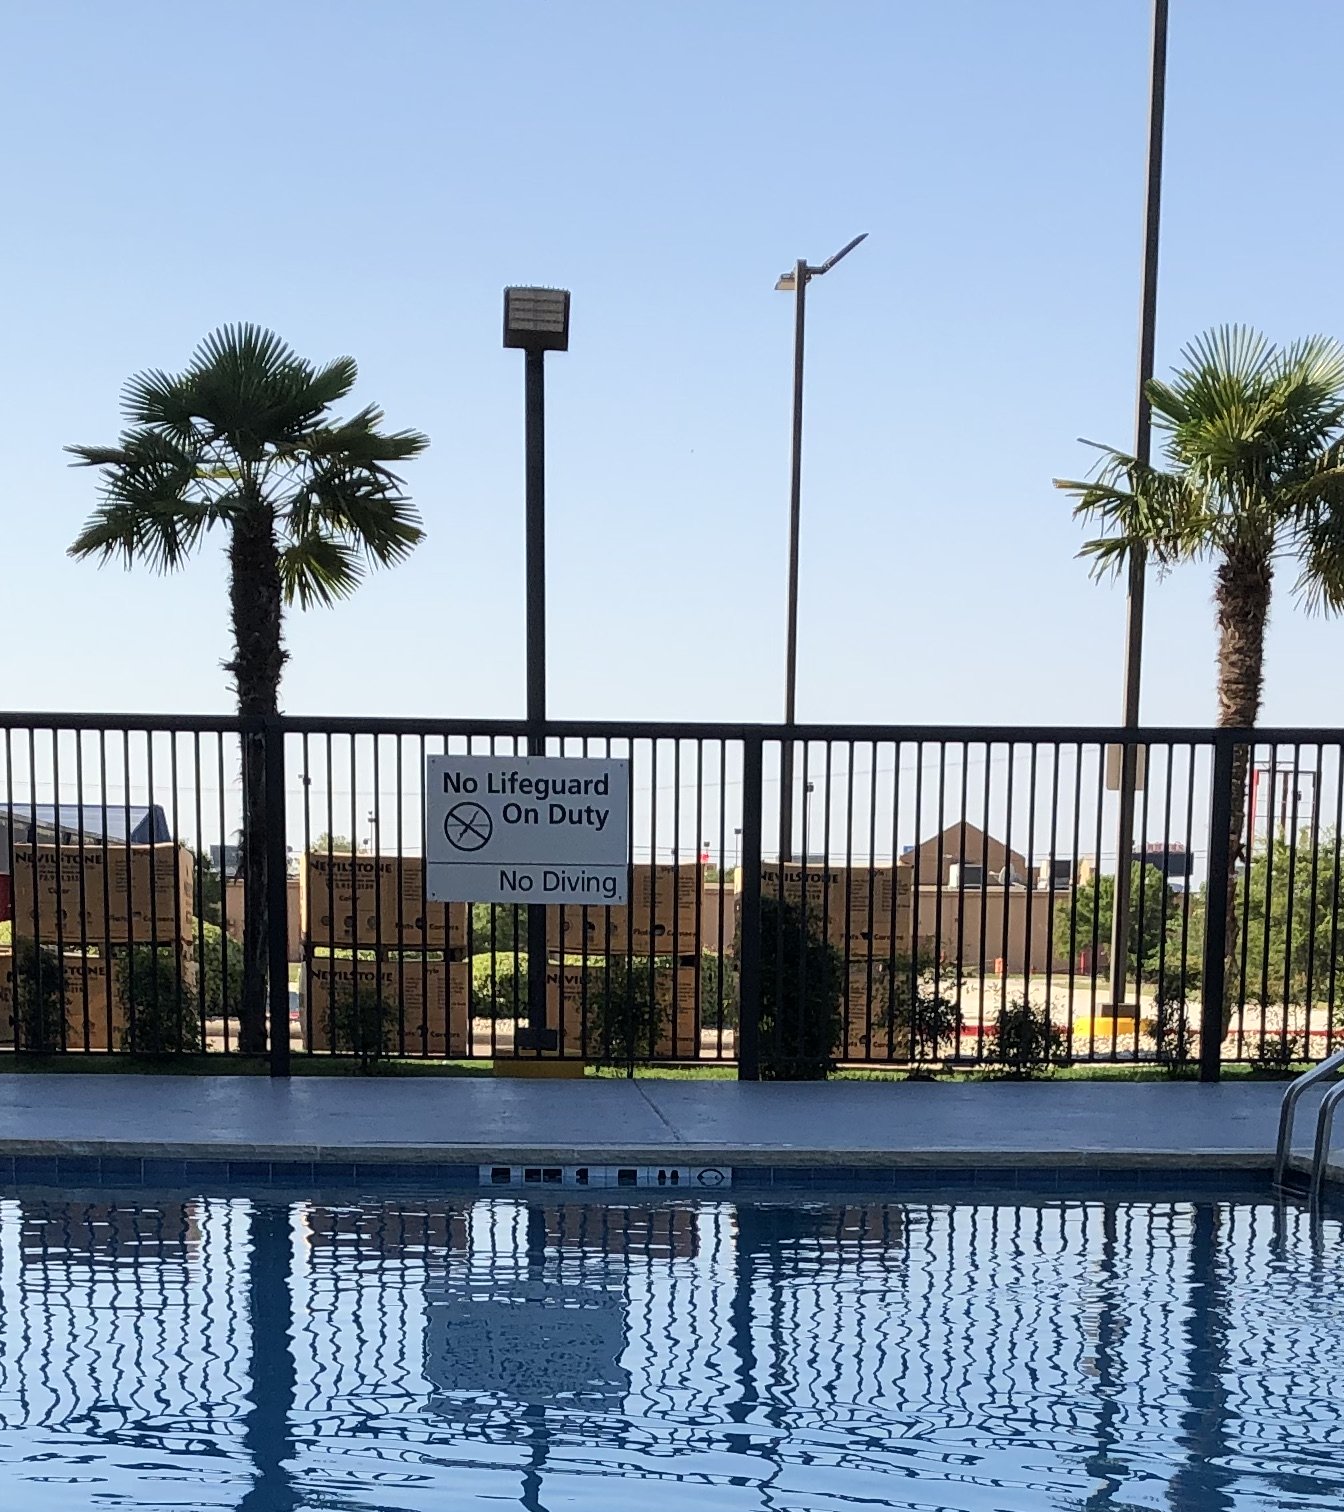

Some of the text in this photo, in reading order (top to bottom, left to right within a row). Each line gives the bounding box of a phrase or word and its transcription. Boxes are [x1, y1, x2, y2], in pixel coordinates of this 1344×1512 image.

[442, 771, 610, 801] No Lifeguard
[502, 802, 610, 832] On Duty
[499, 870, 533, 892] No
[543, 870, 618, 899] Diving
